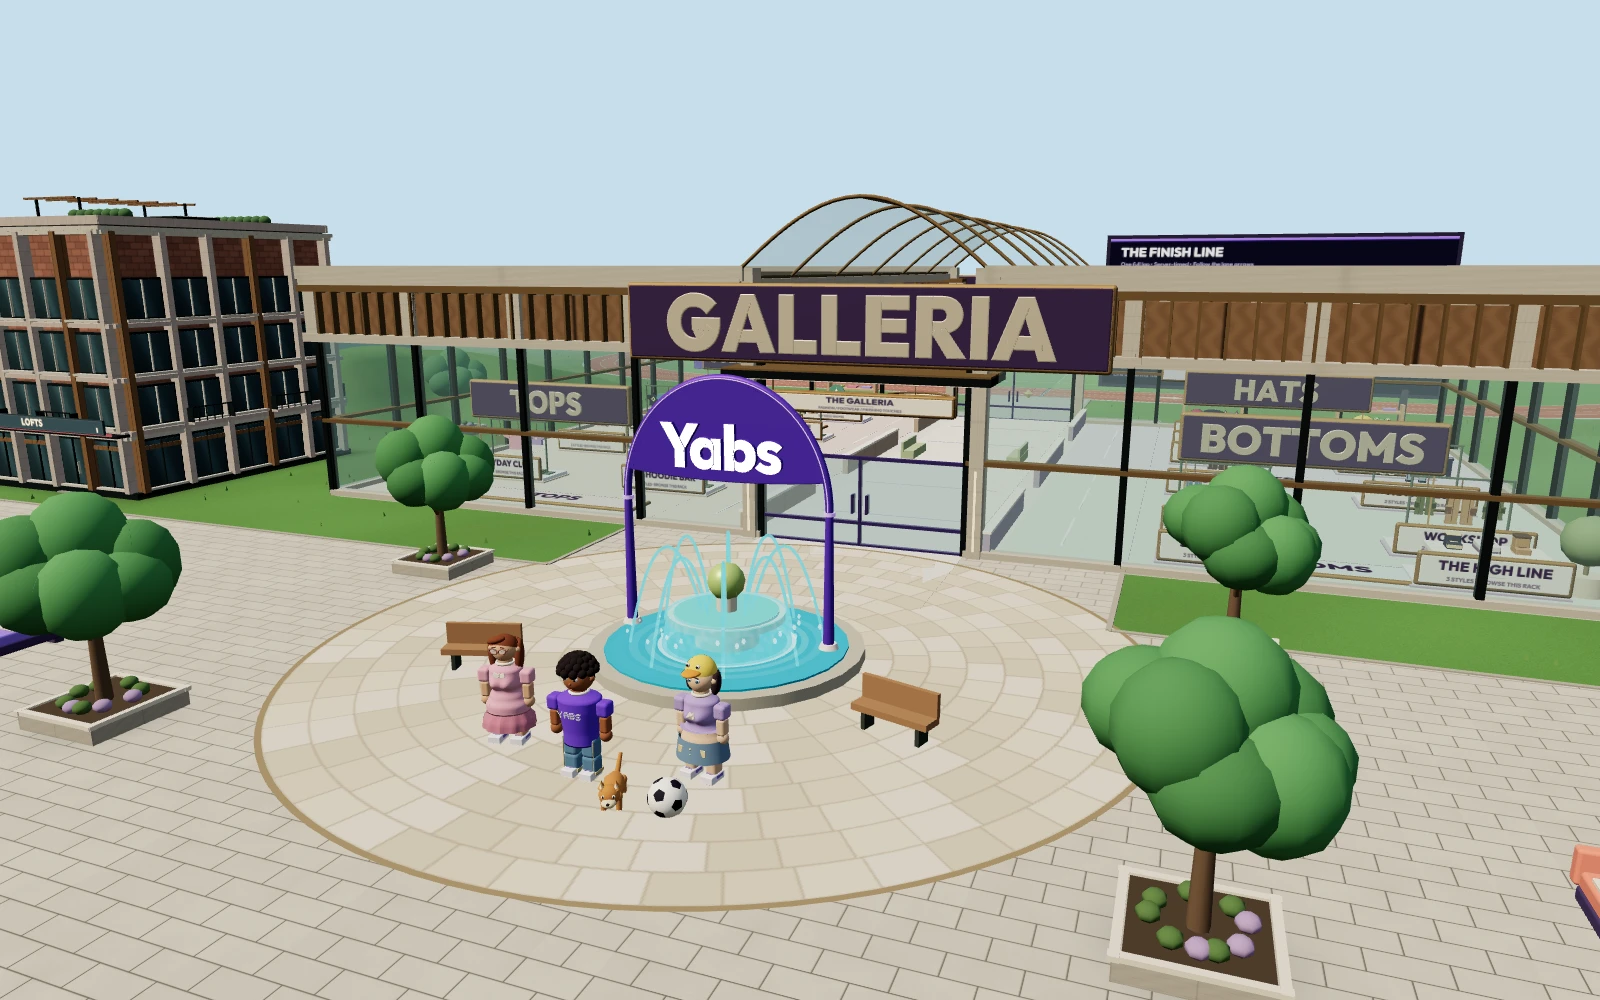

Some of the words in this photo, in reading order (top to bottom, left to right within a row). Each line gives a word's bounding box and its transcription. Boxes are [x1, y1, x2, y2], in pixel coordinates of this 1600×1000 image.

[1121, 247, 1148, 258] THE
[1149, 246, 1192, 258] FINISH
[1193, 246, 1225, 258] LINE
[666, 292, 1057, 363] GALLERIA
[509, 388, 582, 417] TOPS
[825, 396, 845, 404] THE
[846, 398, 894, 407] GALLERIA
[20, 417, 44, 428] LOFTS
[659, 421, 783, 476] Yabs
[1200, 423, 1427, 466] BOTTOMS
[1424, 531, 1508, 546] WOKSP
[1439, 560, 1470, 573] THE
[1472, 563, 1514, 577] HGH
[1516, 566, 1554, 580] LINE
